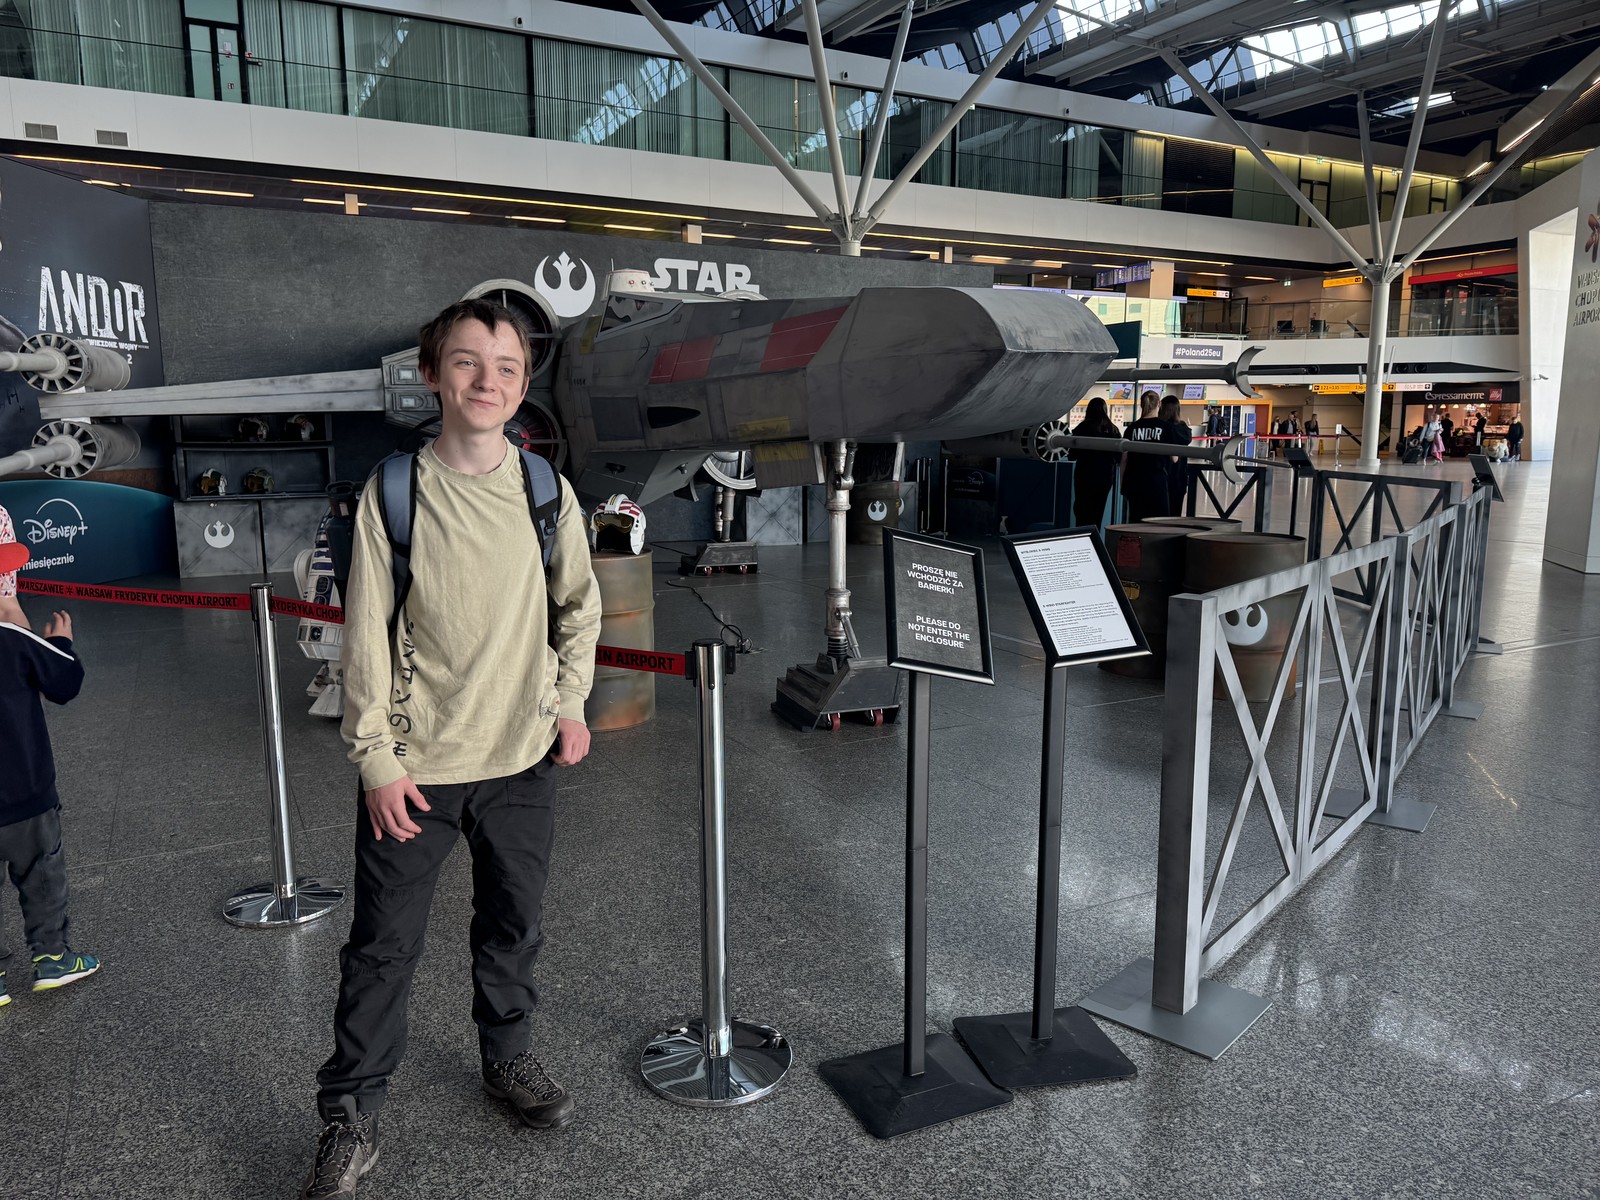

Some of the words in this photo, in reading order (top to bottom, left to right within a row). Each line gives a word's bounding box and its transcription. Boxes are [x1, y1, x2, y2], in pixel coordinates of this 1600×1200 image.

[650, 258, 760, 294] STAR
[38, 266, 149, 343] ANDOR
[86, 339, 118, 349] WIEZDNE
[1175, 347, 1221, 357] #Poland25eu
[1425, 391, 1485, 401] espressamente
[1132, 427, 1163, 441] ANDOR
[23, 519, 88, 545] Disney+
[907, 570, 951, 586] WCHODZIĆ
[952, 580, 964, 588] ZA
[912, 562, 944, 577] PROSZĘ
[945, 570, 958, 579] NIE
[18, 580, 64, 594] WARSZAWIE
[76, 586, 113, 599] WARSAW
[115, 590, 159, 603] FRYDERYK
[161, 594, 195, 606] CHOPIN
[197, 596, 237, 607] AIRPORT
[918, 581, 955, 595] BARIERKI
[916, 615, 948, 628] PLEASE
[948, 621, 961, 630] DO
[908, 622, 926, 632] NOT
[926, 626, 953, 638] ENTER
[954, 631, 970, 641] THE
[915, 633, 964, 649] ENCLOSURE
[616, 652, 676, 670] AIRPORT
